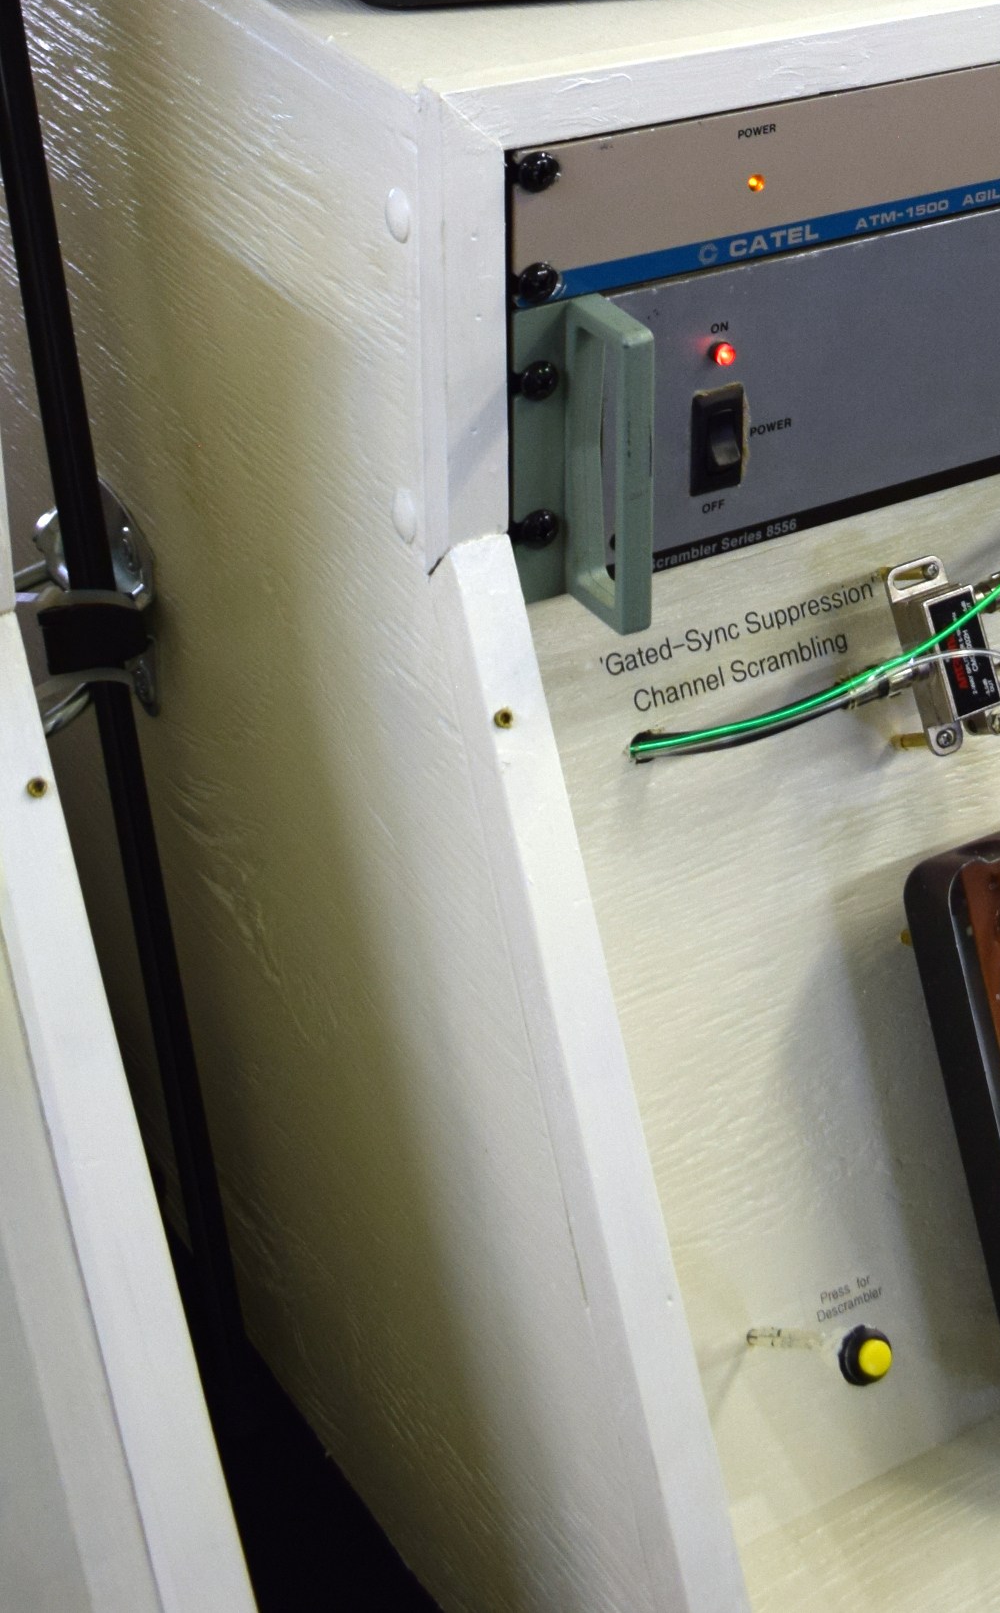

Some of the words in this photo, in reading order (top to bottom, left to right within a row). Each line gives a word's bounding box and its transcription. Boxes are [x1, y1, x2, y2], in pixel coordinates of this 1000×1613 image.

[737, 123, 776, 139] POWER
[729, 224, 819, 258] CATEL
[855, 199, 949, 230] ATM-1500
[710, 321, 729, 334] ON
[750, 418, 792, 436] POWER
[702, 499, 725, 514] OFF
[721, 530, 762, 552] Series
[766, 518, 798, 538] 8556
[633, 666, 725, 712] Channel
[730, 633, 848, 683] Scrambling
[820, 1284, 850, 1304] Press
[856, 1275, 870, 1289] for
[816, 1286, 883, 1323] Descrambler
